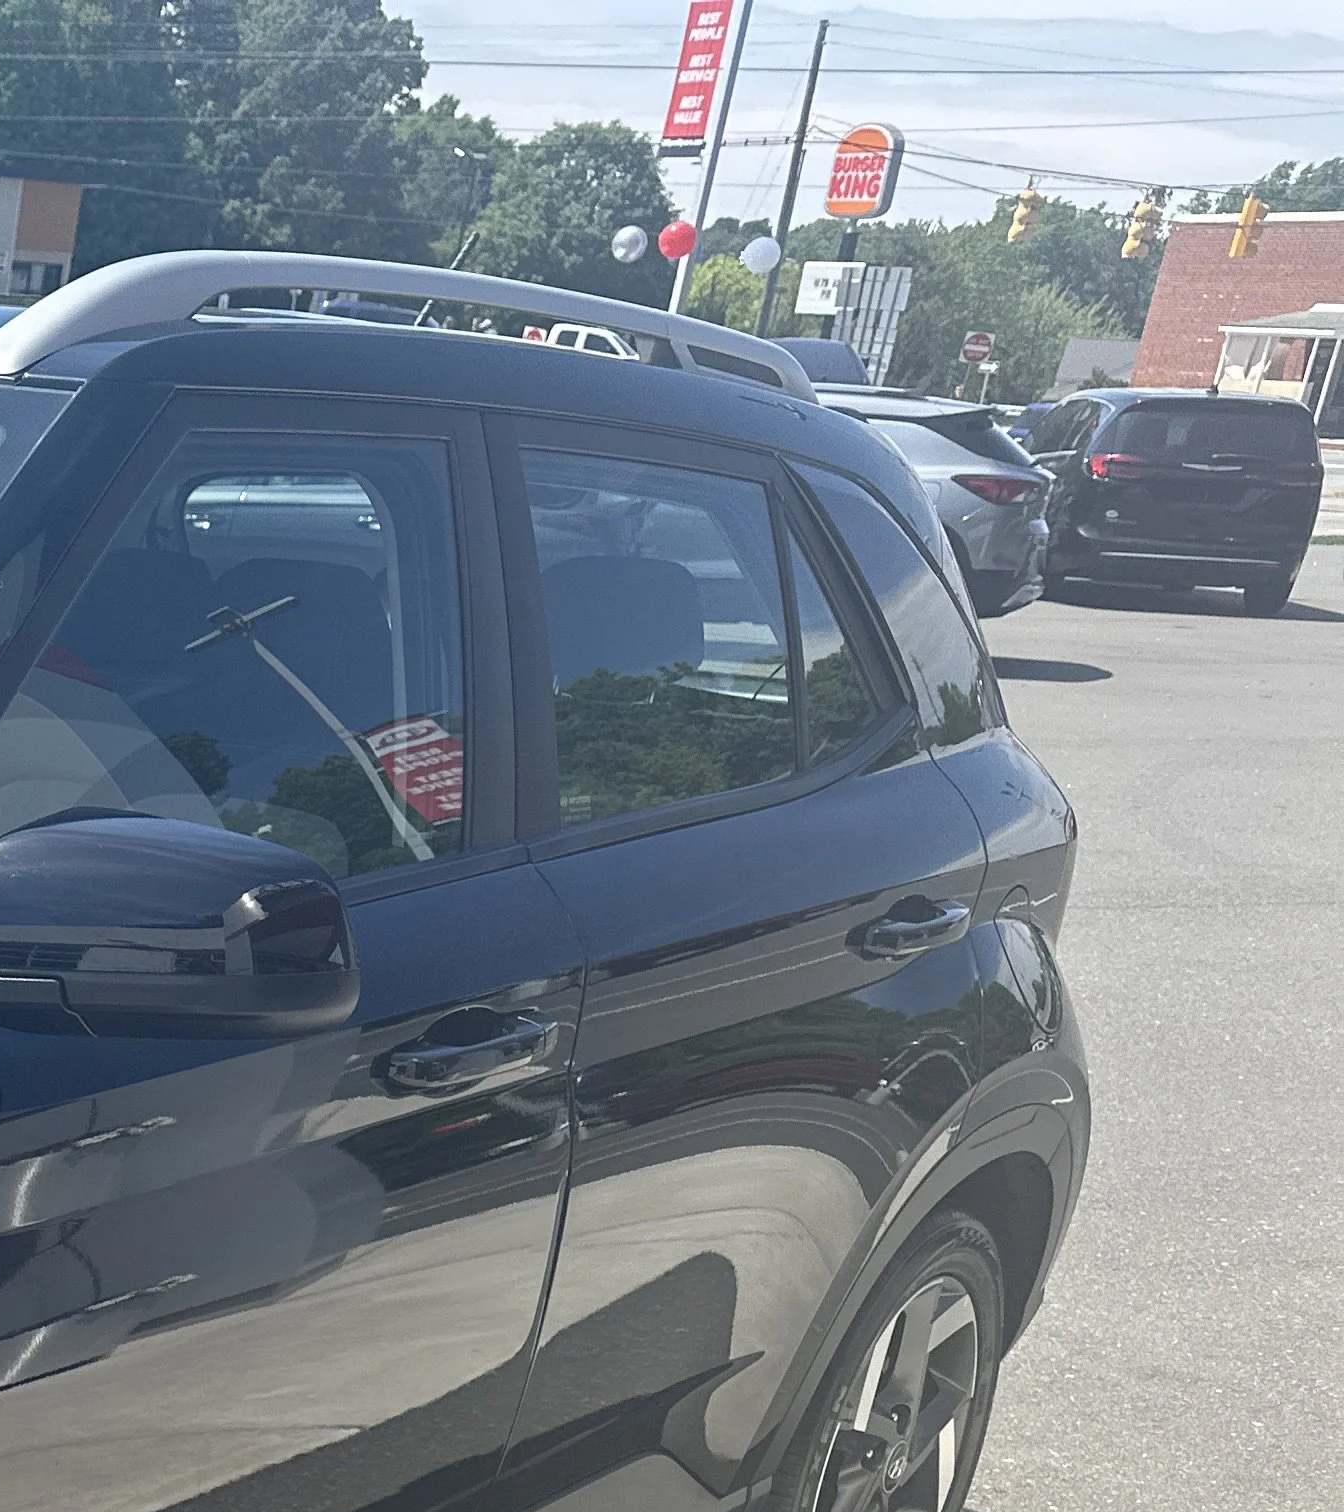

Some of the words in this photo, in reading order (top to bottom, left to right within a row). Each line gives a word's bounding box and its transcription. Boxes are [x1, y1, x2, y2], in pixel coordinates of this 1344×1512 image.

[697, 11, 723, 26] BEST
[689, 26, 725, 41] PEOPLE
[689, 53, 714, 68] BEST
[678, 68, 717, 83] SERVICE
[679, 95, 704, 109] BEST
[831, 155, 887, 173] BURGER
[827, 174, 883, 200] KING
